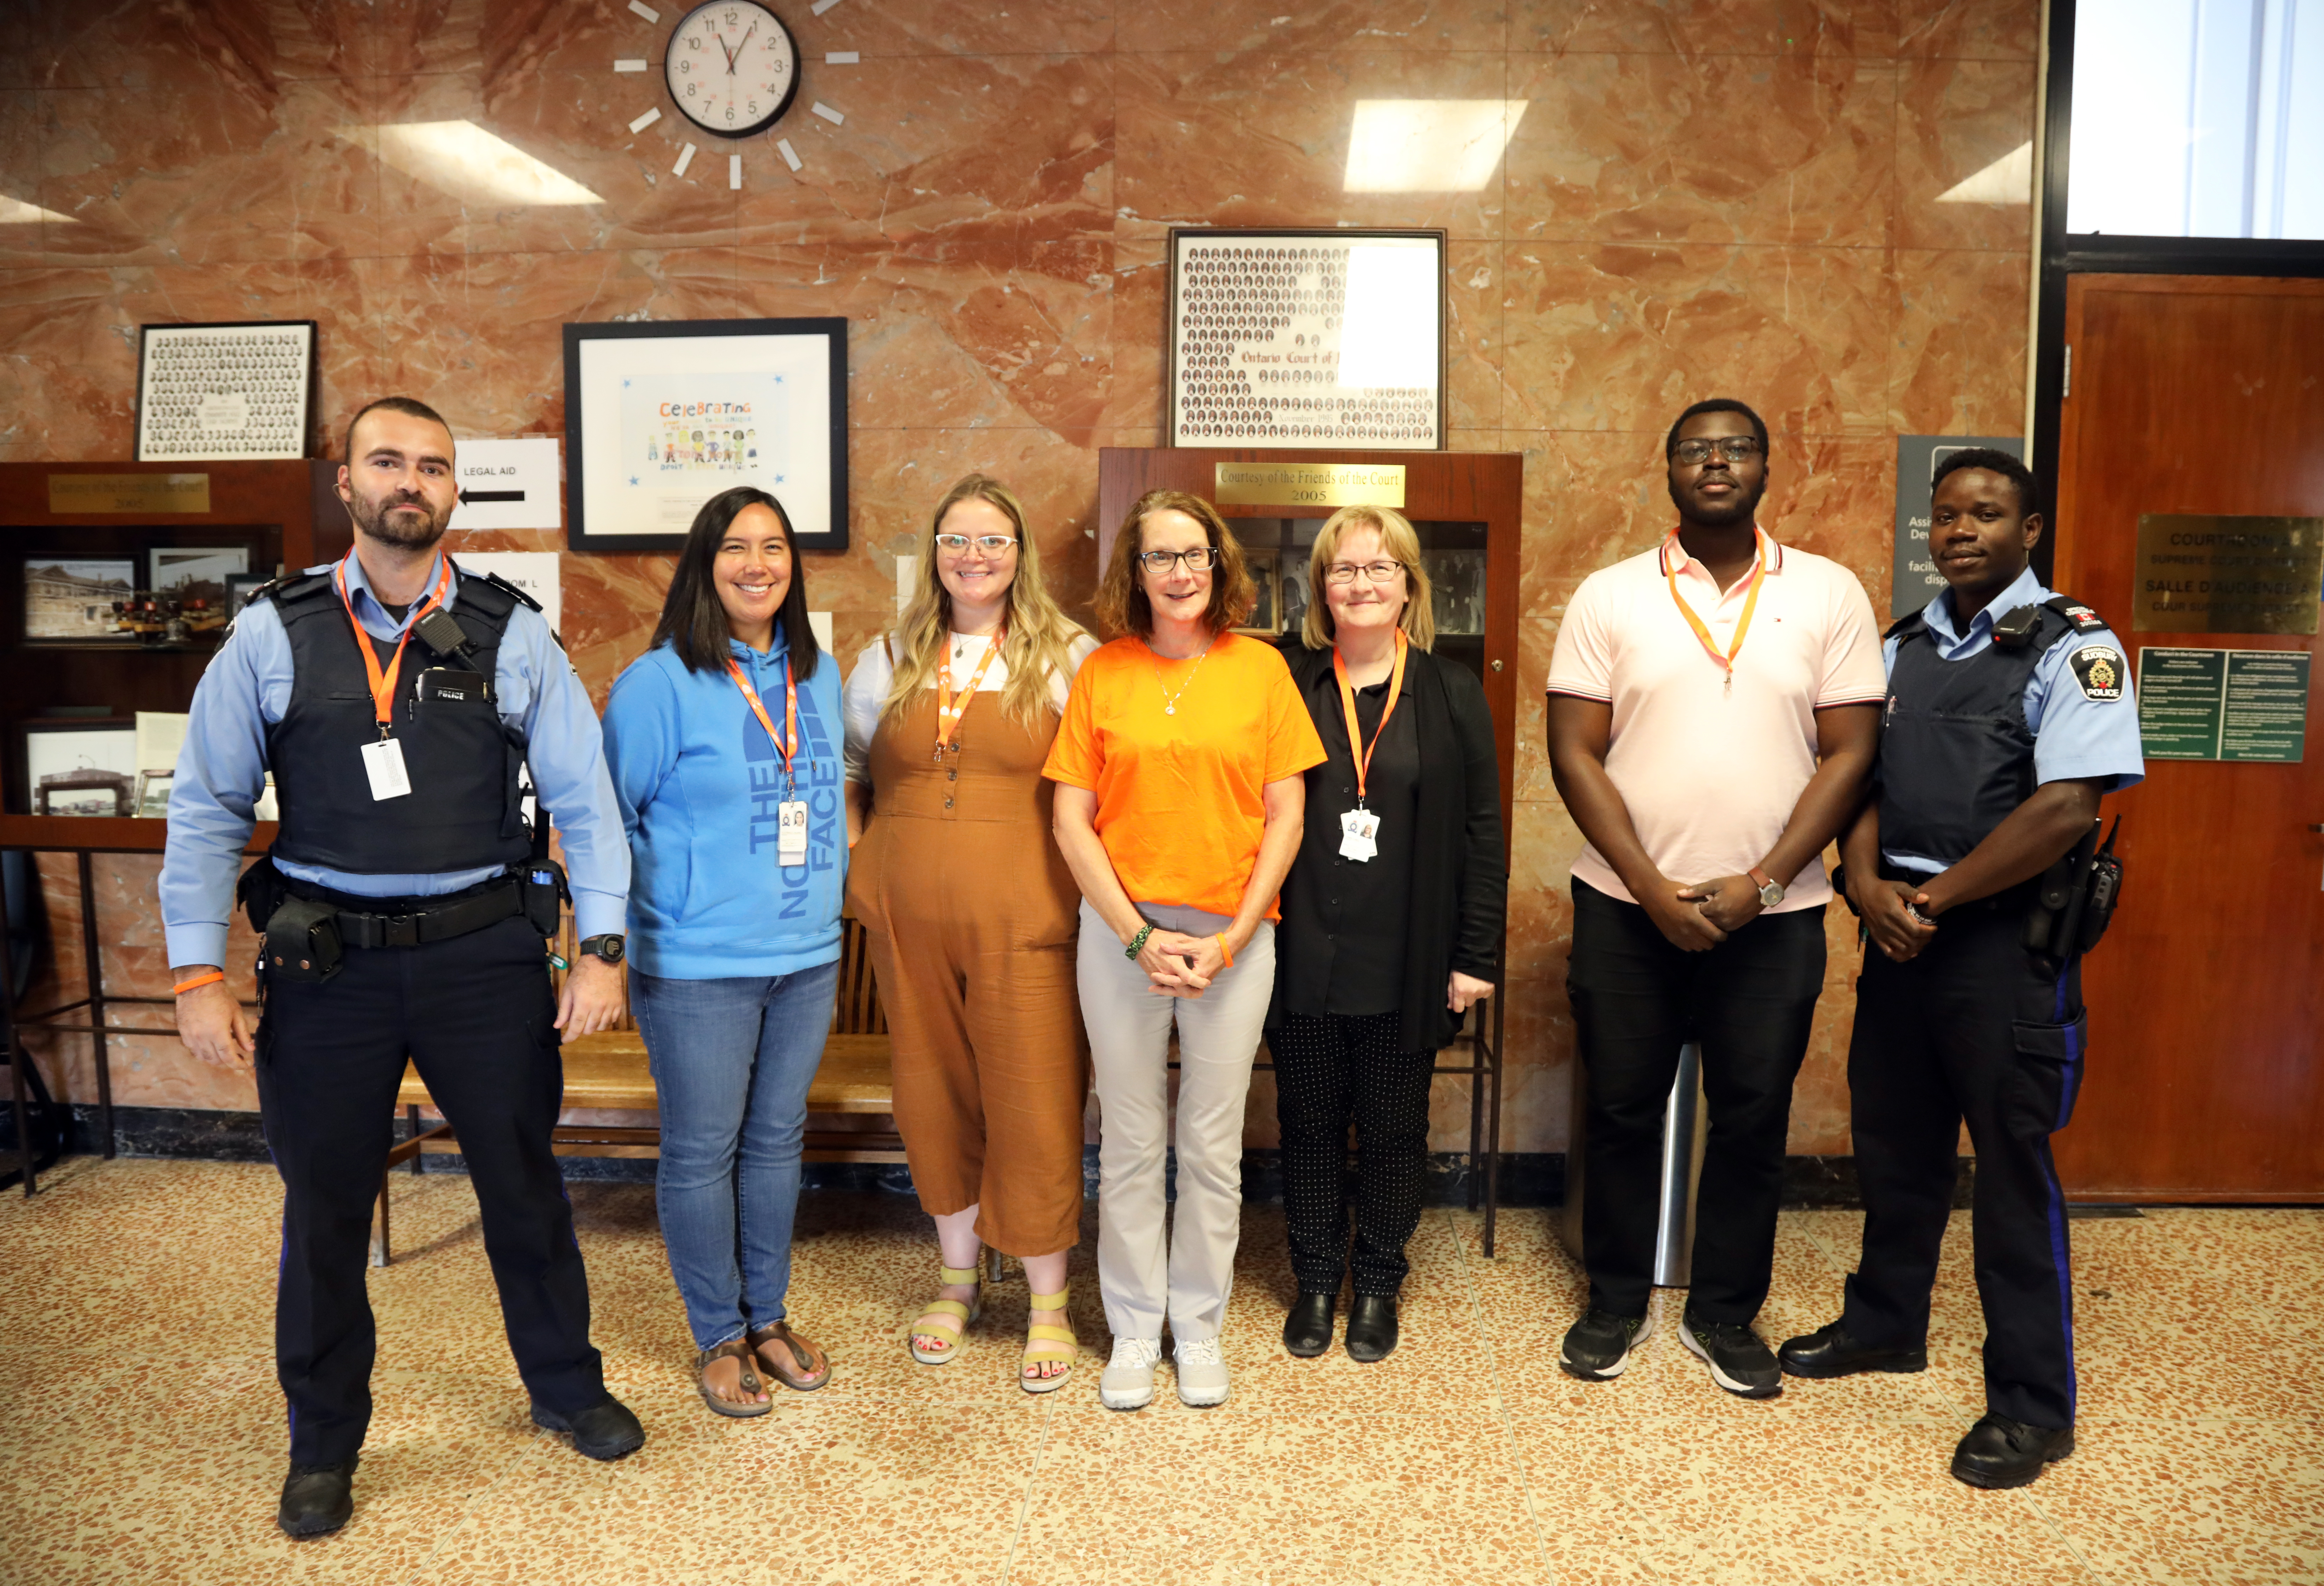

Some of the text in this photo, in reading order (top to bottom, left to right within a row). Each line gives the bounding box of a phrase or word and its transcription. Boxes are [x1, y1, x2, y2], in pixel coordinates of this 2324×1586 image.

[724, 12, 737, 25] 12
[704, 19, 714, 32] 11
[752, 19, 758, 32] 1
[689, 37, 700, 50] 10
[768, 37, 776, 49] 2
[681, 60, 689, 73] 9
[774, 59, 783, 72] 3
[687, 83, 696, 96] 8
[767, 83, 775, 94] 4
[704, 100, 712, 113] 7
[748, 101, 757, 114] 5
[725, 107, 734, 120] 6
[1241, 350, 1281, 363] Ontario
[1286, 351, 1318, 364] Court
[1322, 350, 1333, 364] of
[1278, 414, 1315, 422] November
[464, 467, 516, 475] LEGAL AID
[1221, 469, 1399, 486] Courtesy of the Friends of the Court
[1292, 490, 1327, 501] 2005
[1909, 516, 1932, 527] Assi
[1910, 529, 1930, 540] Dev
[2170, 533, 2273, 547] COURTROOM
[2151, 554, 2205, 565] SUPREME
[1925, 574, 1949, 587] disp
[2146, 580, 2194, 593] SALLE
[2300, 583, 2309, 594] A
[2081, 652, 2117, 662] SUDBURY
[438, 690, 465, 700] POLICE
[2086, 688, 2119, 697] POLICE
[748, 764, 780, 855] THE
[810, 761, 837, 872] FACE
